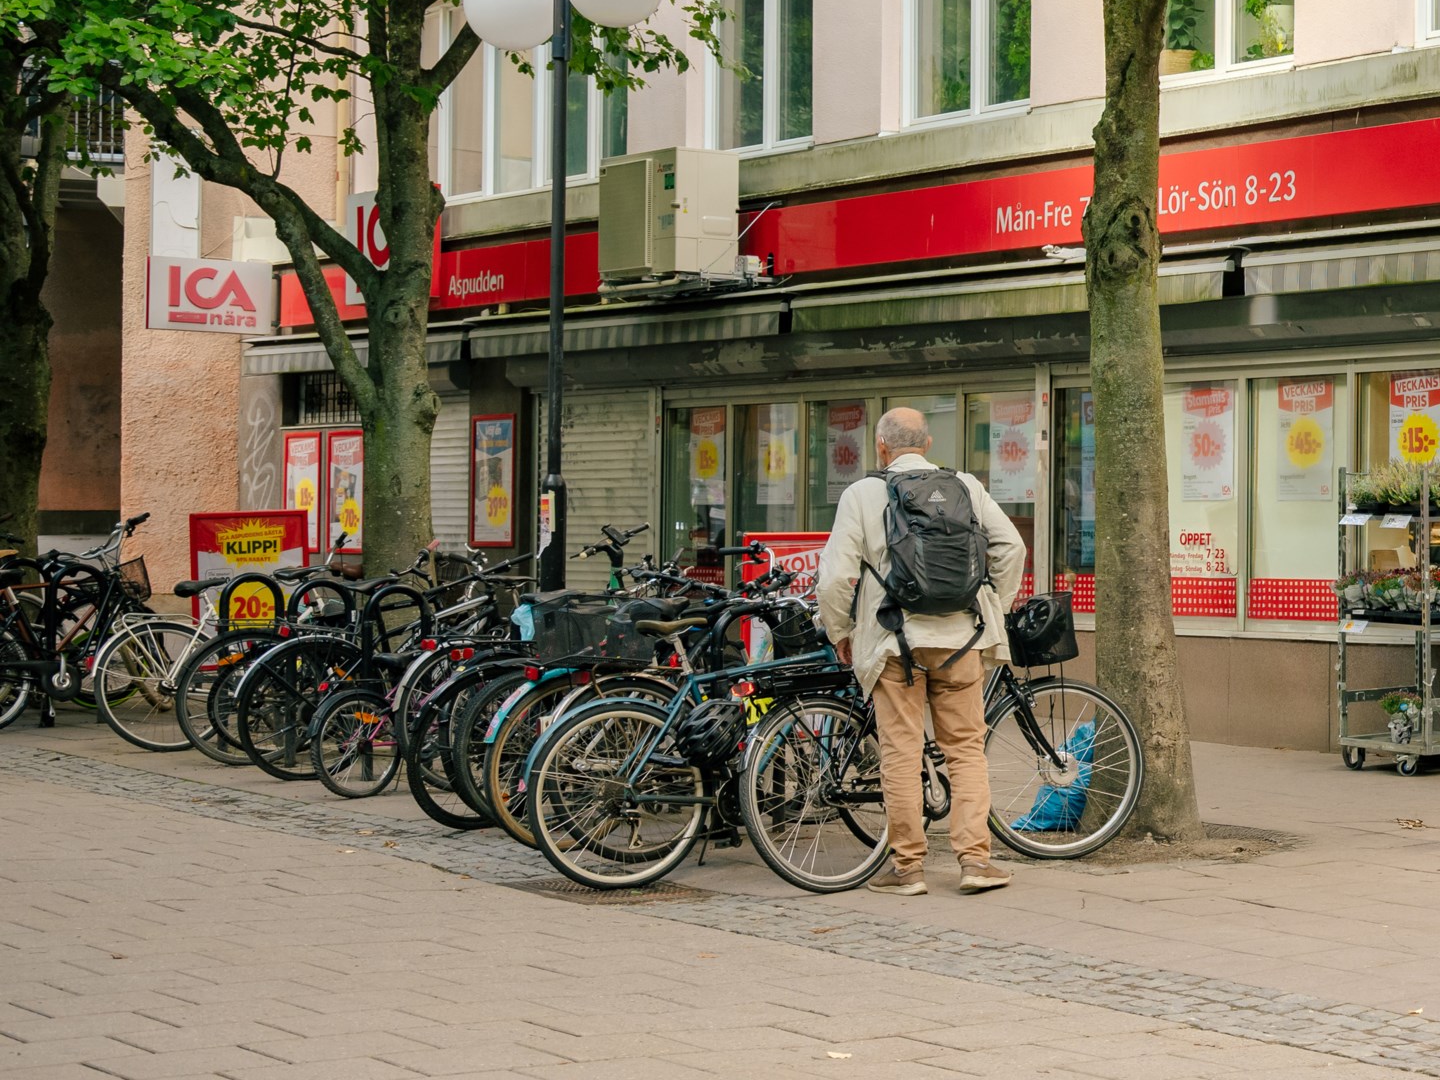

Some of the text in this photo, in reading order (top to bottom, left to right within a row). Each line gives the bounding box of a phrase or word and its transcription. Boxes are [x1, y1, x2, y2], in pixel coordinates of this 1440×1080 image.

[1158, 170, 1296, 215] Lör-Sön 8-23
[996, 201, 1072, 234] Mån-Fre
[357, 203, 390, 267] IC
[169, 266, 256, 311] ICA
[449, 271, 504, 297] Aspudden
[209, 312, 257, 328] nära
[1284, 383, 1324, 398] VECKANS
[1396, 376, 1439, 393] VECKANS
[1294, 400, 1315, 412] PRIS
[1406, 395, 1427, 408] PRIS
[1408, 427, 1436, 453] 15:-
[1180, 529, 1212, 546] ÖPPET
[226, 540, 277, 555] KLIPP!
[1206, 548, 1225, 560] 7-23
[1206, 561, 1225, 572] 8-23
[234, 596, 275, 619] 20:-
